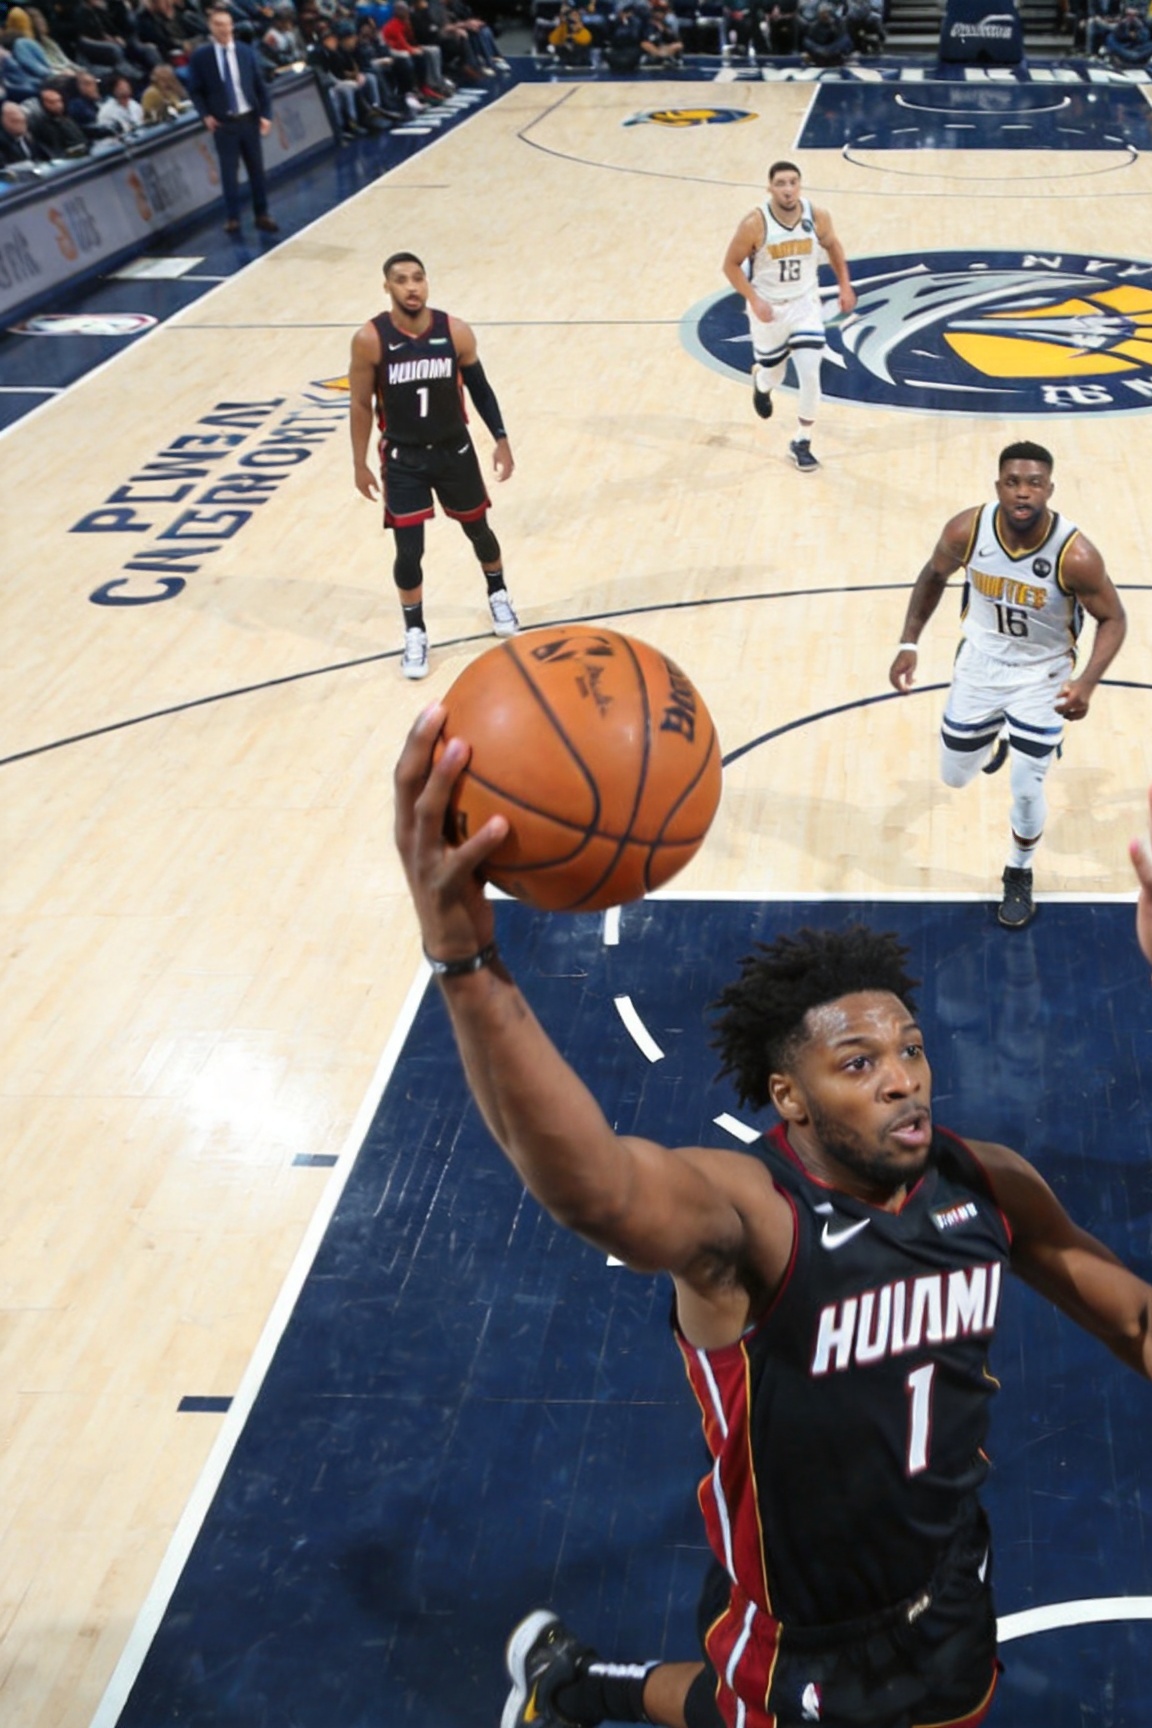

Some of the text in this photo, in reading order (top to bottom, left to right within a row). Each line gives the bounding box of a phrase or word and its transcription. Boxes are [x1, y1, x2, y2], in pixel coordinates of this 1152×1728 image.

[416, 387, 428, 418] 1
[995, 603, 1029, 638] 16
[907, 1362, 935, 1474] 1
